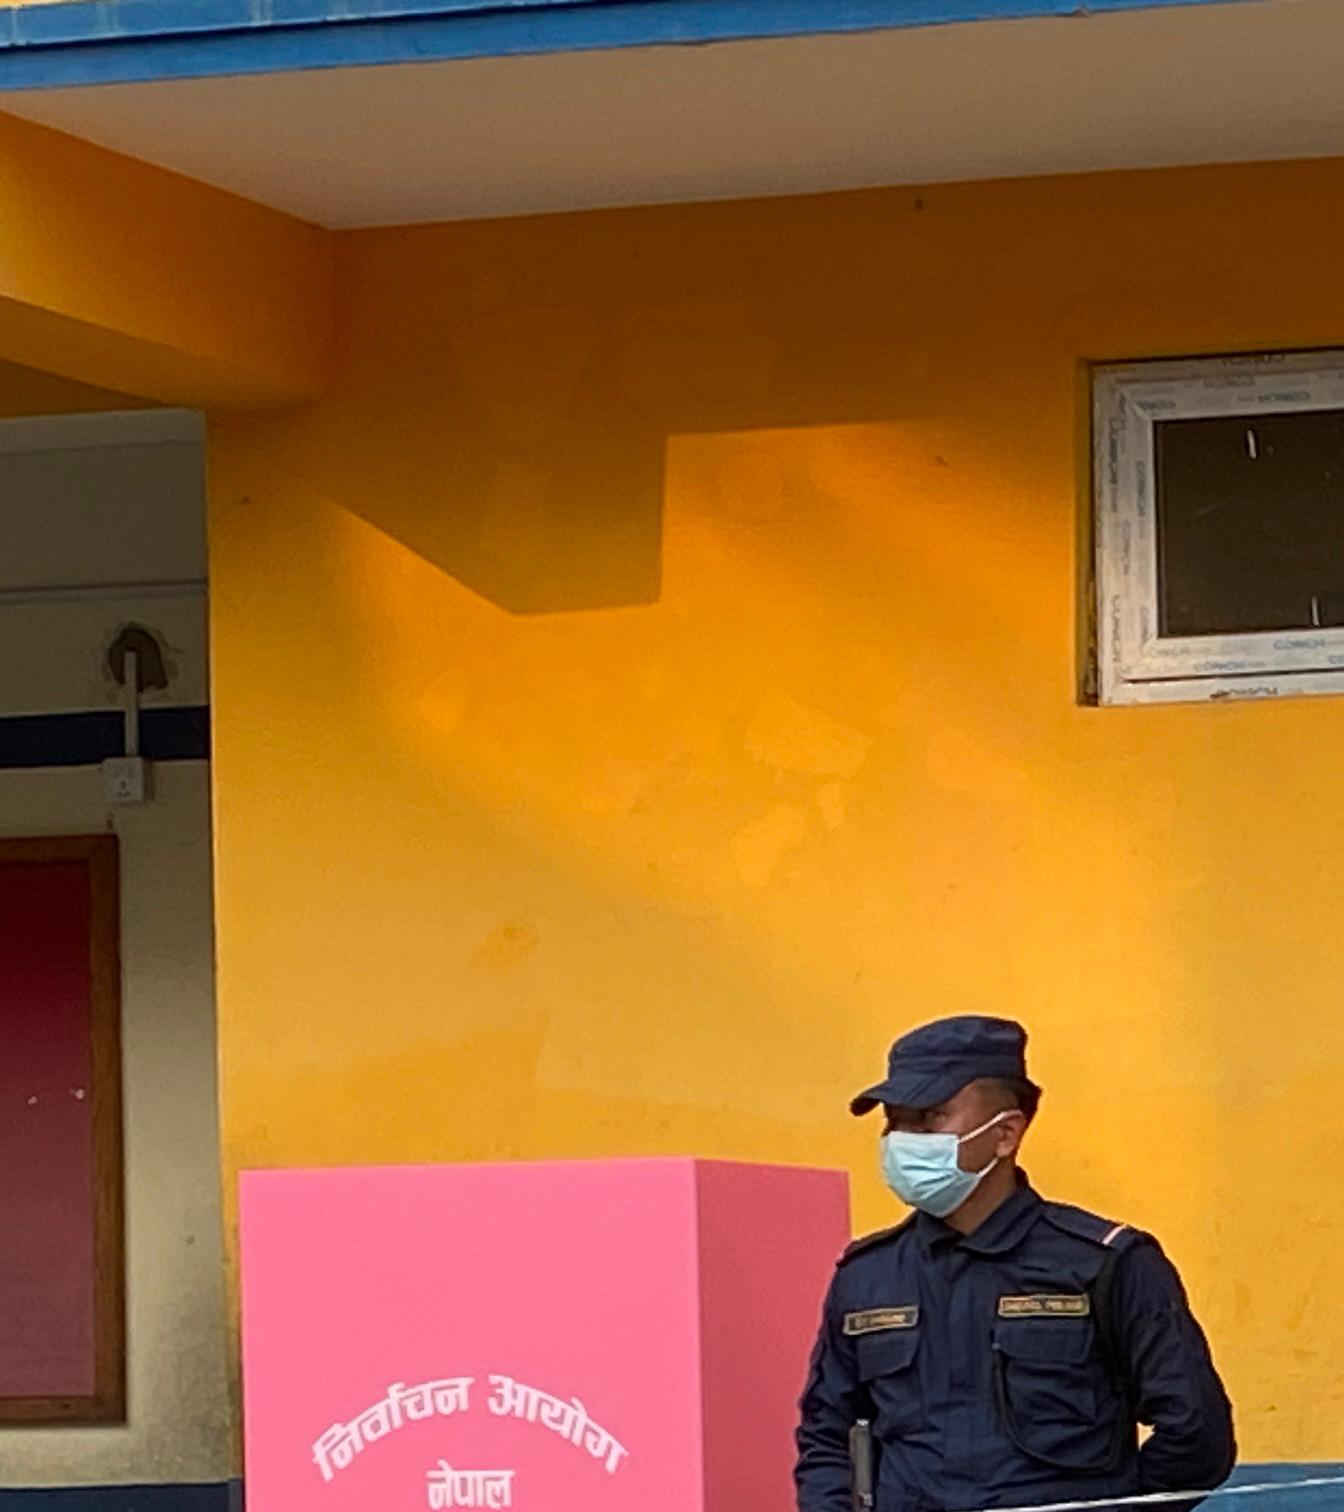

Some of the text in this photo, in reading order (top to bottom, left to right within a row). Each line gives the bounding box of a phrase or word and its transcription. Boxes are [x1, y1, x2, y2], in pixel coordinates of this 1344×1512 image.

[312, 1374, 628, 1482] निर्वाचन आयोग
[426, 1460, 515, 1510] नेपाल
